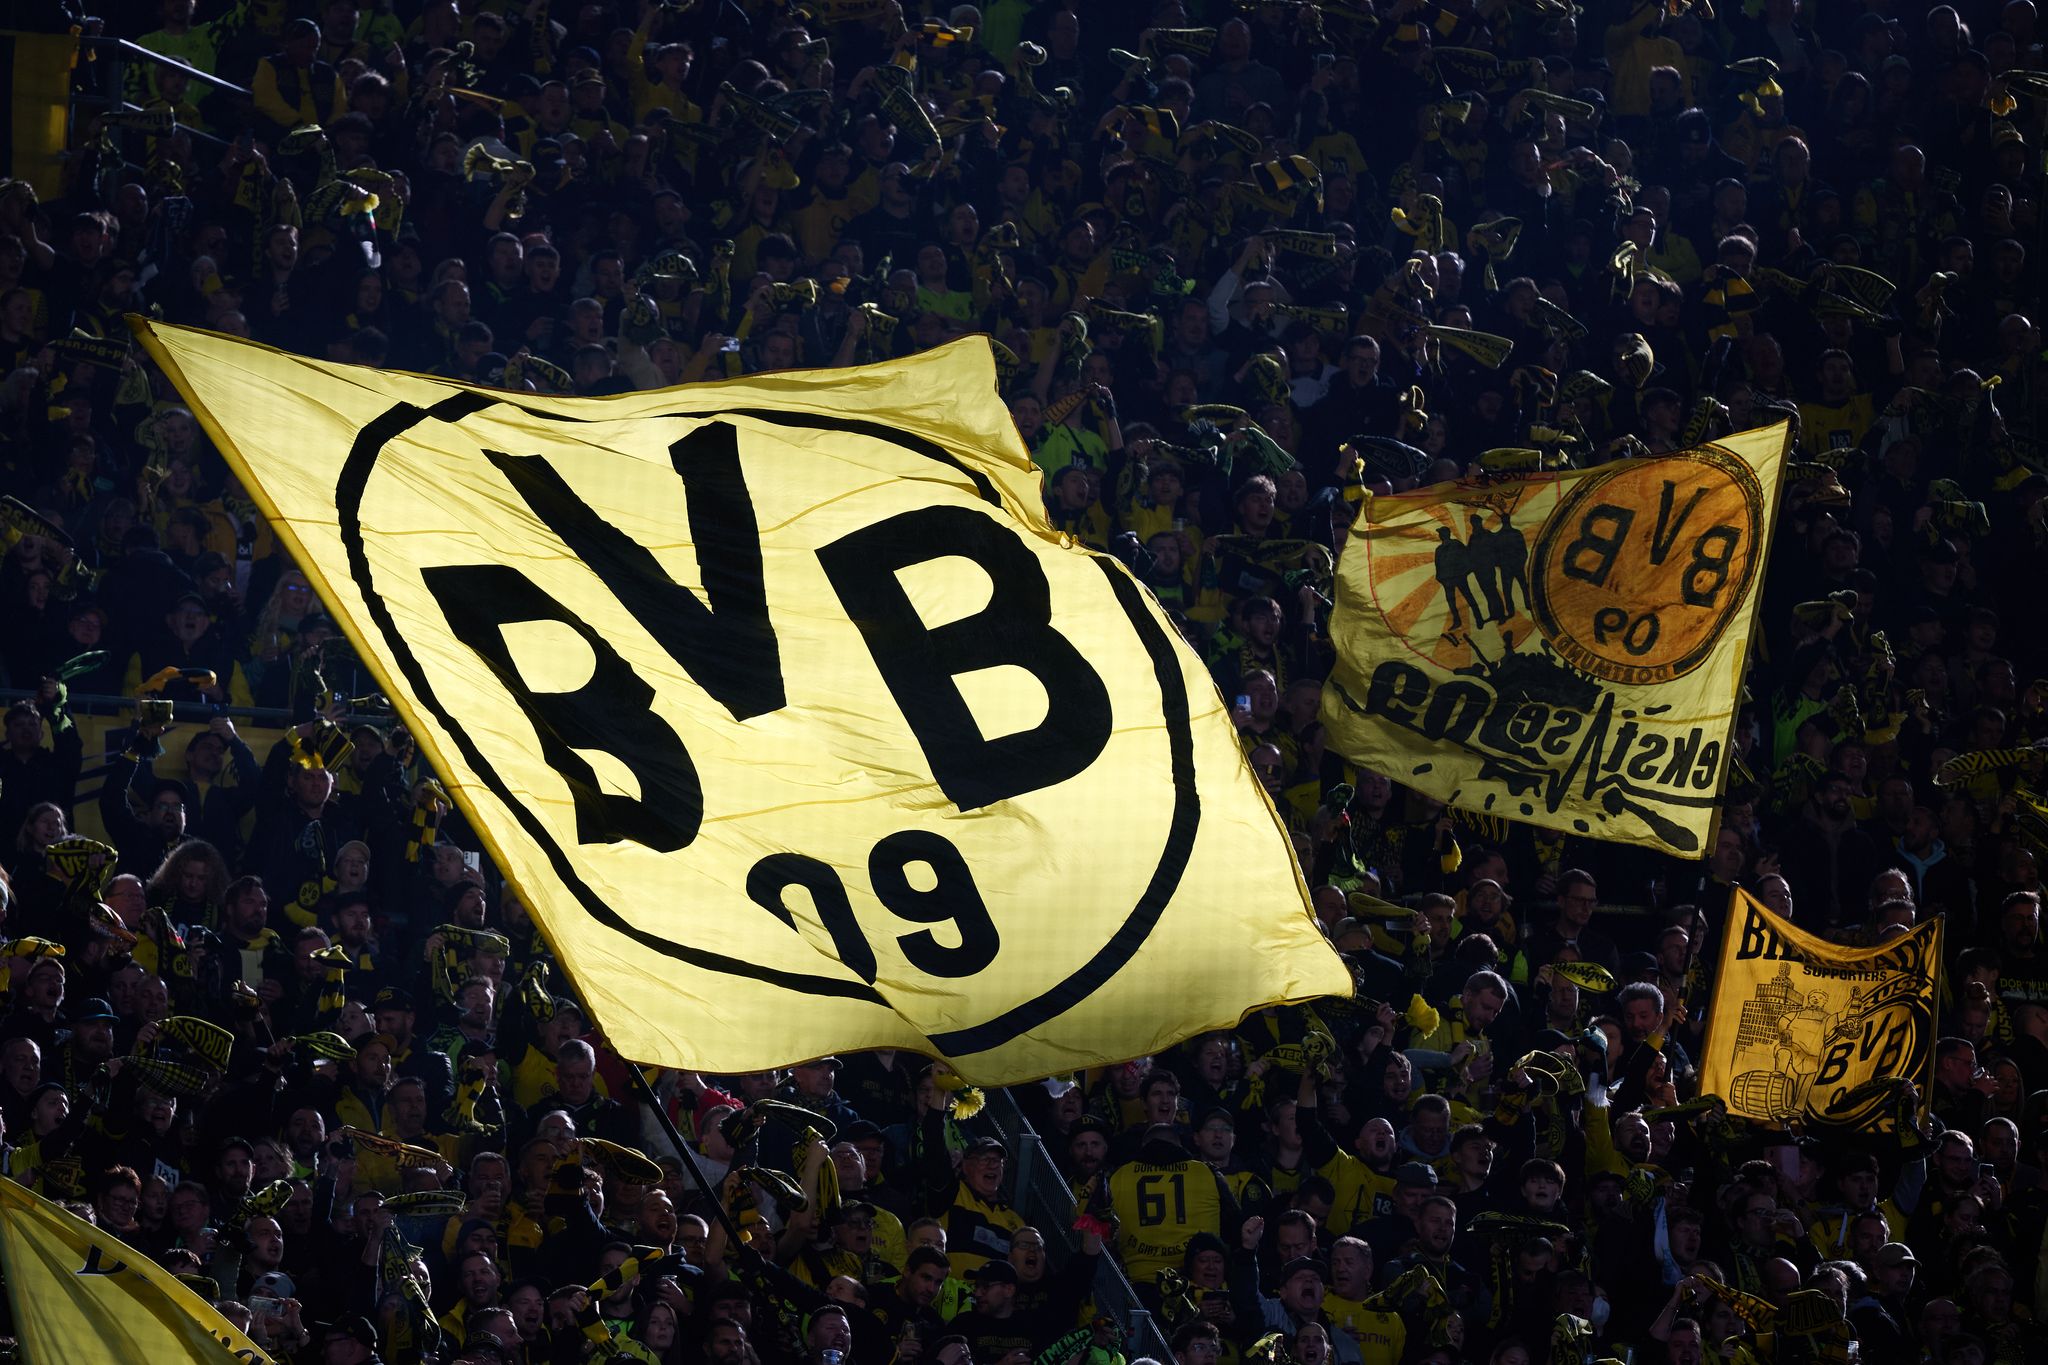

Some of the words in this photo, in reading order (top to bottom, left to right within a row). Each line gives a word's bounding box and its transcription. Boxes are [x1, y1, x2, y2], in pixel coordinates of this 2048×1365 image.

[421, 422, 1113, 853] BVB
[1802, 965, 1888, 982] SUPPORTERS
[1814, 1011, 1908, 1086] BVB
[1134, 1162, 1188, 1173] DORTMUND
[1136, 1174, 1187, 1227] 61
